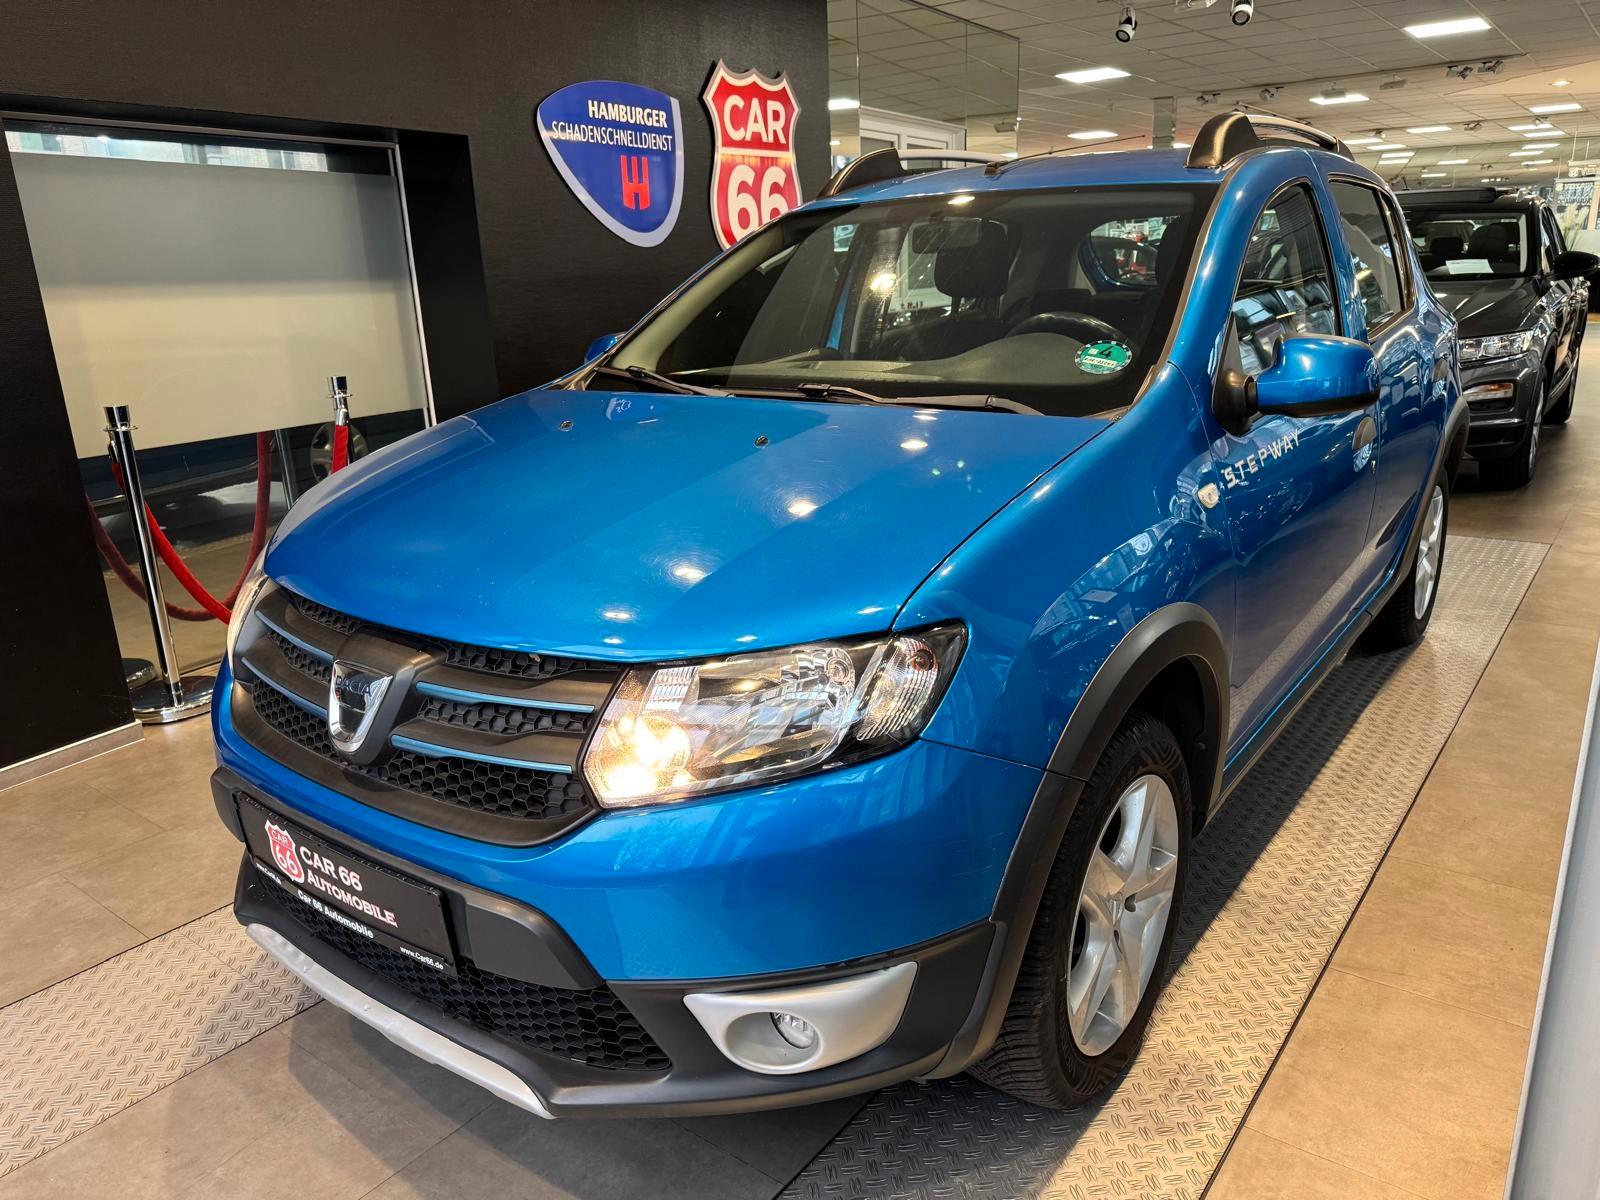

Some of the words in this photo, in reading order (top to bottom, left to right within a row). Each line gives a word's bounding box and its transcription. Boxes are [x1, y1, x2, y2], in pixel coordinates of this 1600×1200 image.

[588, 99, 668, 128] HAMBURGER
[723, 94, 787, 145] CAR
[551, 121, 673, 151] SCHADENSCHNELLDIENST
[727, 164, 789, 242] 66
[1099, 346, 1114, 358] 4
[1224, 430, 1301, 489] STEPWAY
[336, 676, 372, 697] DACIA
[271, 830, 289, 846] CAR
[275, 844, 299, 875] 66
[300, 845, 338, 880] CAR
[338, 865, 363, 892] 66
[297, 889, 312, 905] Car
[324, 905, 374, 939] Automobile
[307, 868, 399, 929] AUTOMOBILE
